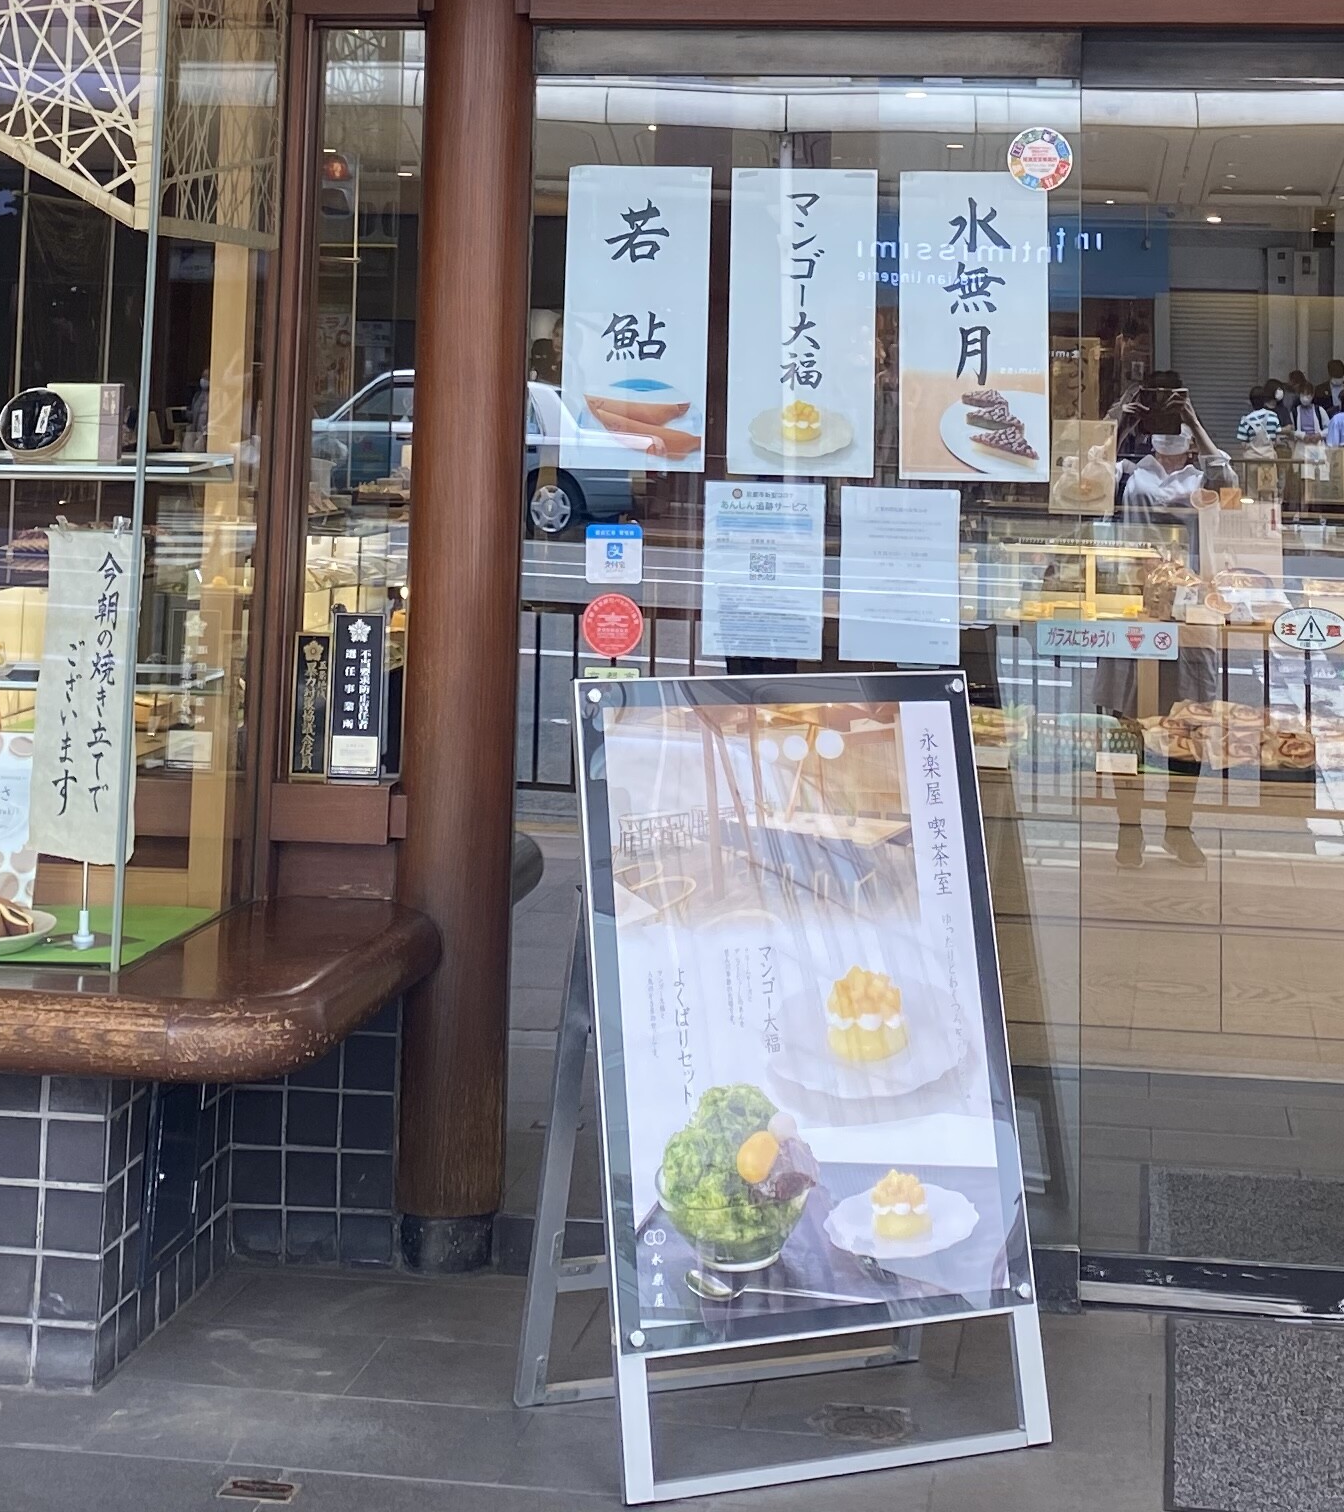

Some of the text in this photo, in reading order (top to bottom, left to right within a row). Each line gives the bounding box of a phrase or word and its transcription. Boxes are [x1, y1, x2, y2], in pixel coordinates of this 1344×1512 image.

[600, 198, 670, 363] 若鮎
[779, 191, 824, 392] マンゴー大福
[943, 197, 1011, 387] 水無月
[721, 501, 808, 511] あんしん追跡サービス
[86, 551, 126, 814] 今朝の焼き立てで
[342, 649, 357, 729] 選任事業所
[1045, 627, 1115, 648] ガラスにちゅうい
[51, 641, 86, 817] ございます
[919, 728, 952, 896] 永楽屋 喫茶室
[674, 968, 695, 1105] よくばりセット
[758, 946, 781, 1053] マンゴー大福
